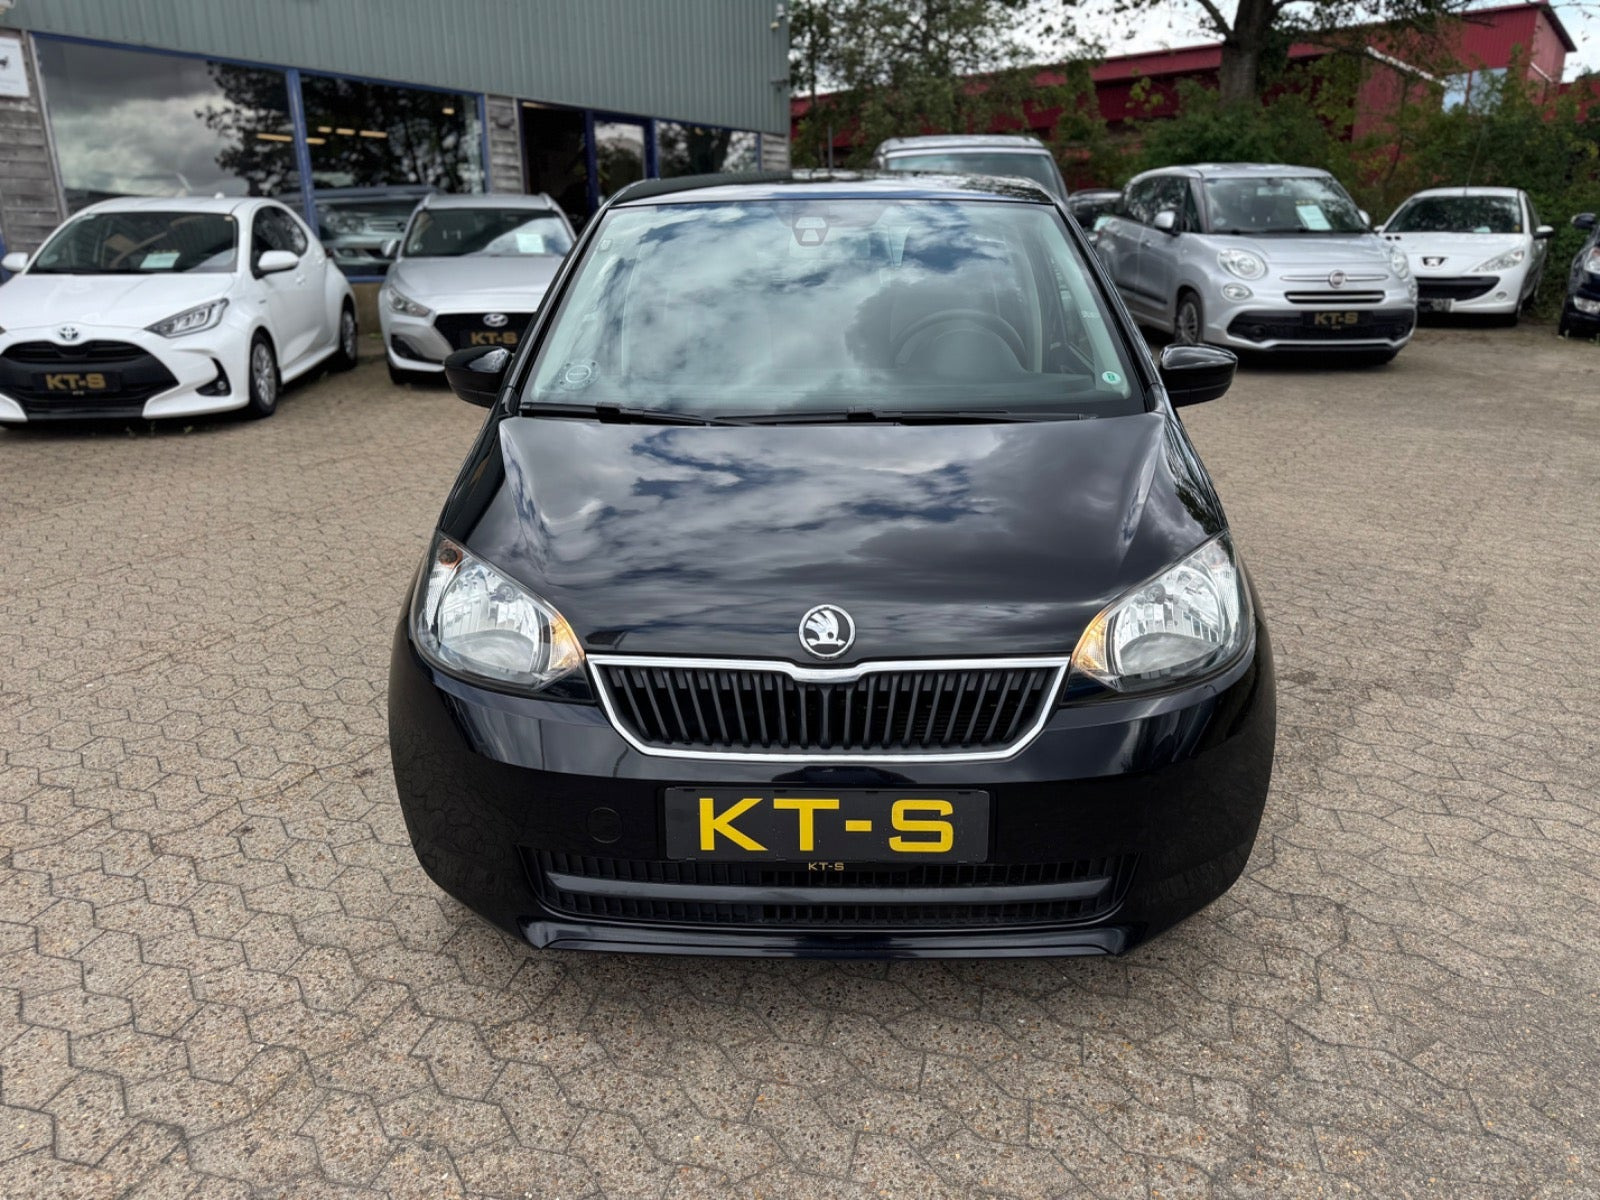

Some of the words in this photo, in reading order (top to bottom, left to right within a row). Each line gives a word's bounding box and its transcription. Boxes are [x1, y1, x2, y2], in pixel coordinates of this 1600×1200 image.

[1314, 312, 1358, 325] KT-S
[470, 331, 518, 345] KT-S
[45, 373, 106, 390] KT-S
[699, 798, 954, 852] KT-S
[808, 861, 845, 871] KT-S
